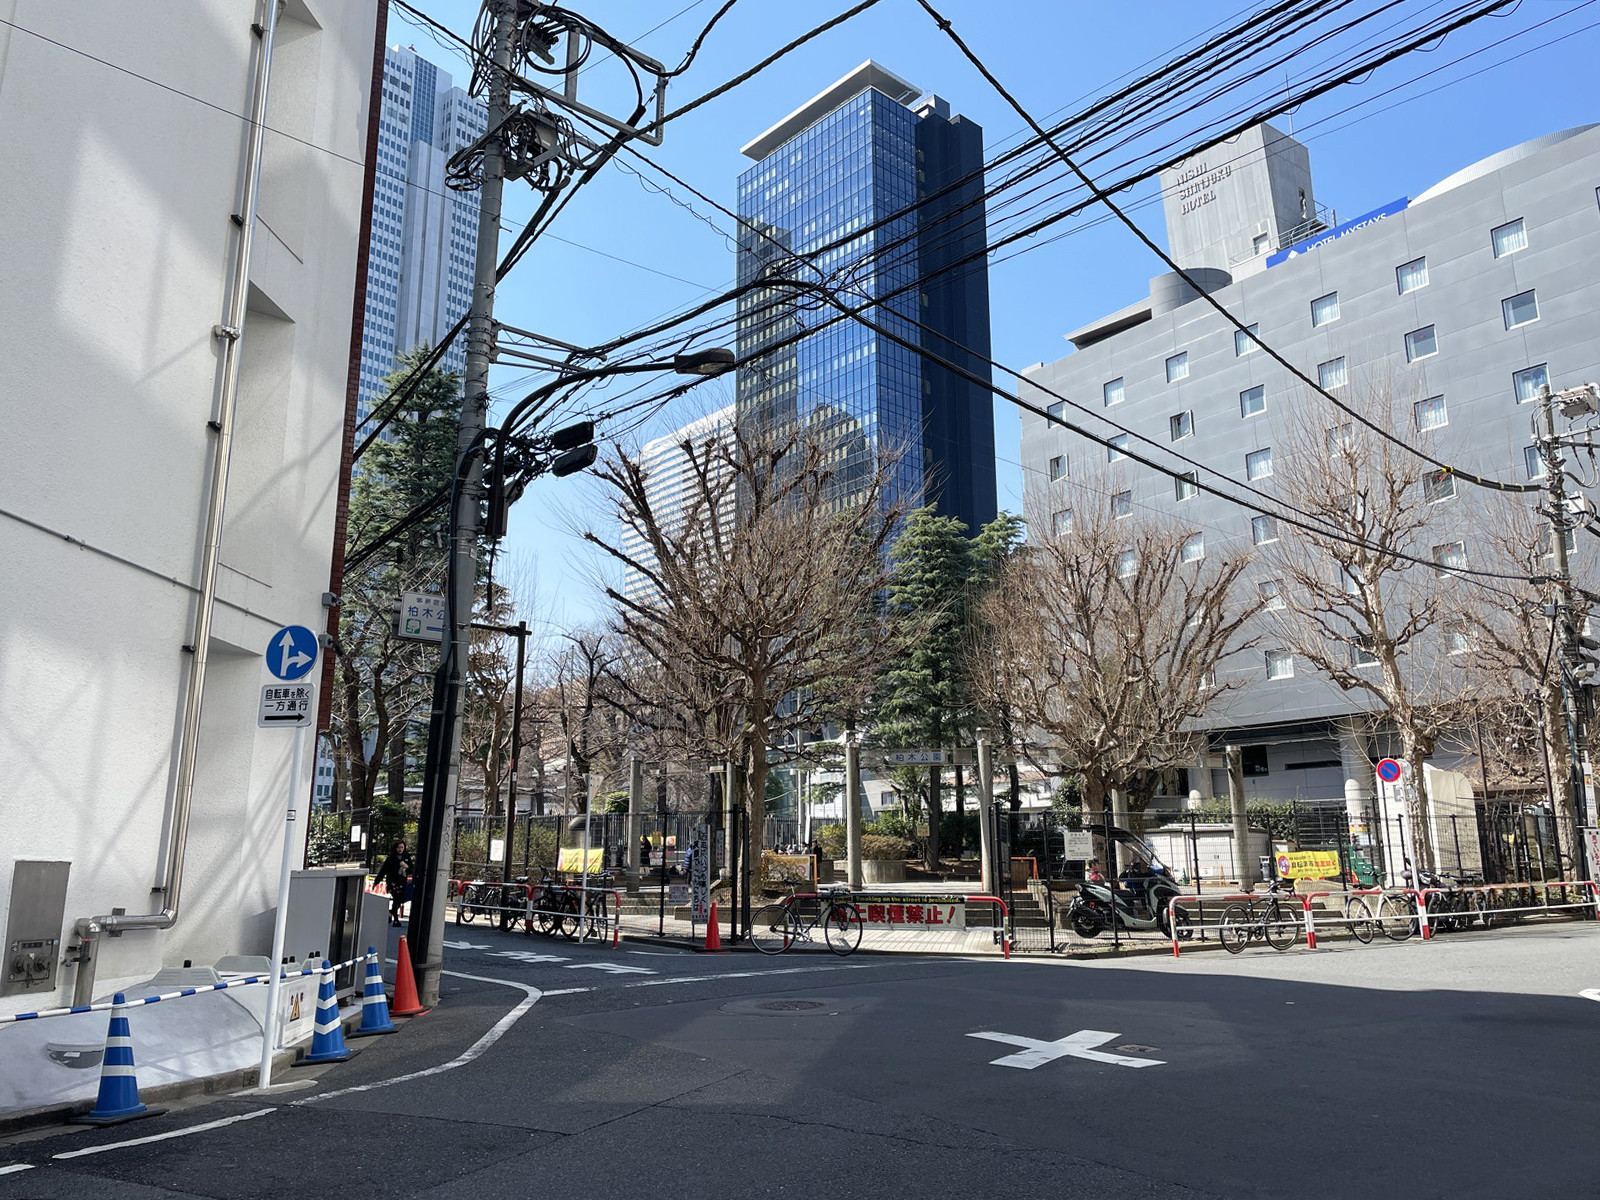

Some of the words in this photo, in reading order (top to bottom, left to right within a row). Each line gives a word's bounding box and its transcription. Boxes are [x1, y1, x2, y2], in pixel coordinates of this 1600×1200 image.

[1176, 162, 1208, 187] NISHI
[1179, 165, 1232, 201] SHINJUKU
[1181, 190, 1217, 216] HOTEL
[1306, 234, 1337, 252] HOTEL
[265, 687, 310, 700] 自転車を除く
[264, 699, 309, 712] 一方通行
[895, 752, 942, 762] 柏木公園
